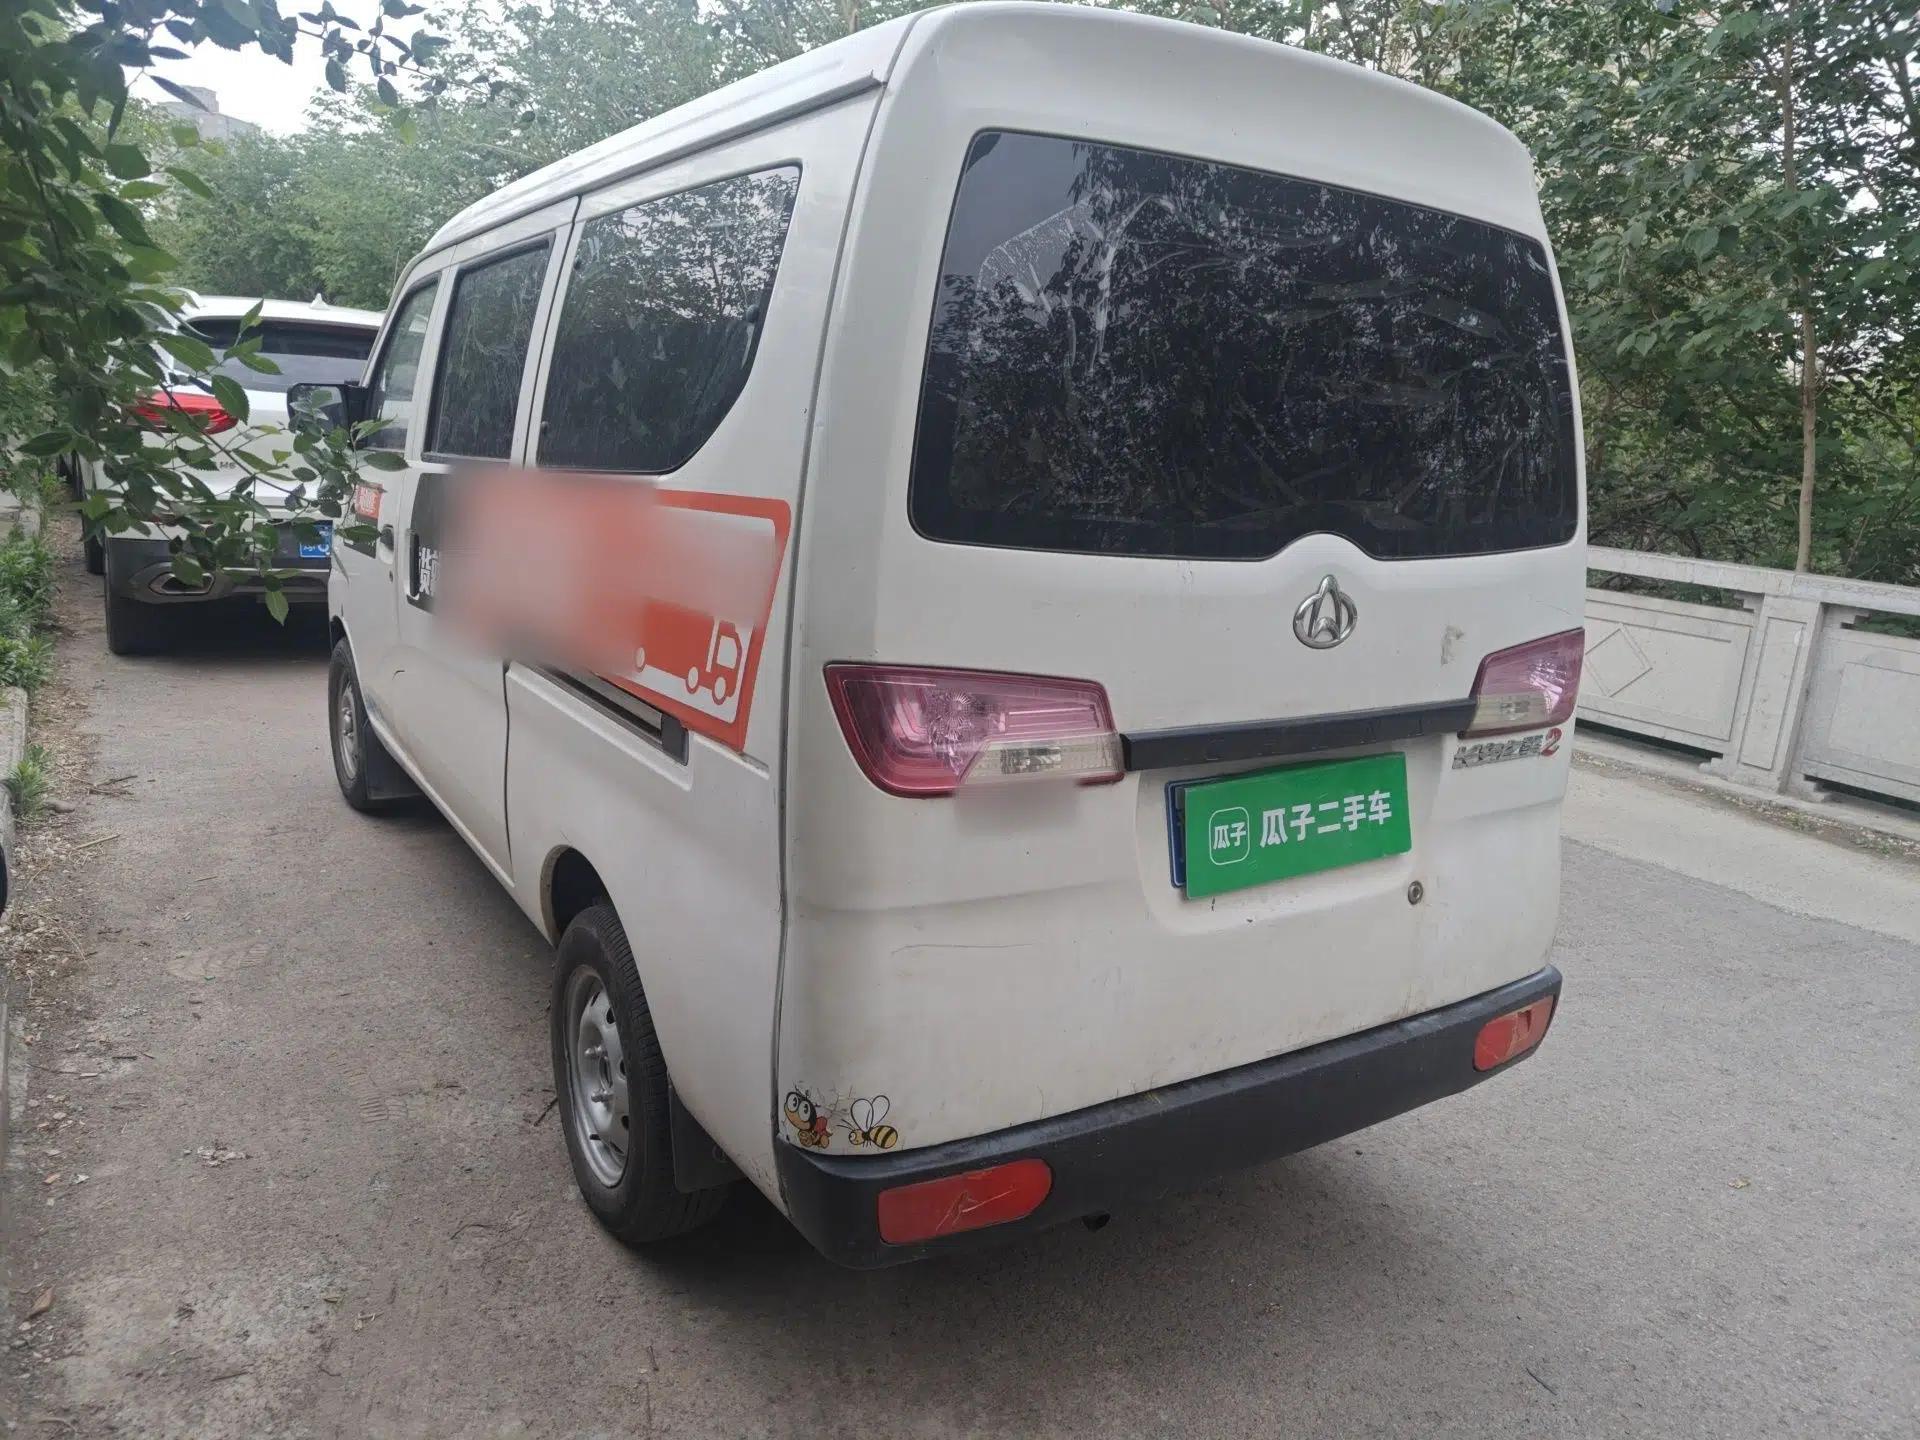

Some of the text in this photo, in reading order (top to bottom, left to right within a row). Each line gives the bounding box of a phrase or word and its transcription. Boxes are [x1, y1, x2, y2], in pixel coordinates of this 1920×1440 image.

[1213, 822, 1247, 850] 瓜子
[1260, 790, 1392, 848] 瓜子二手车
